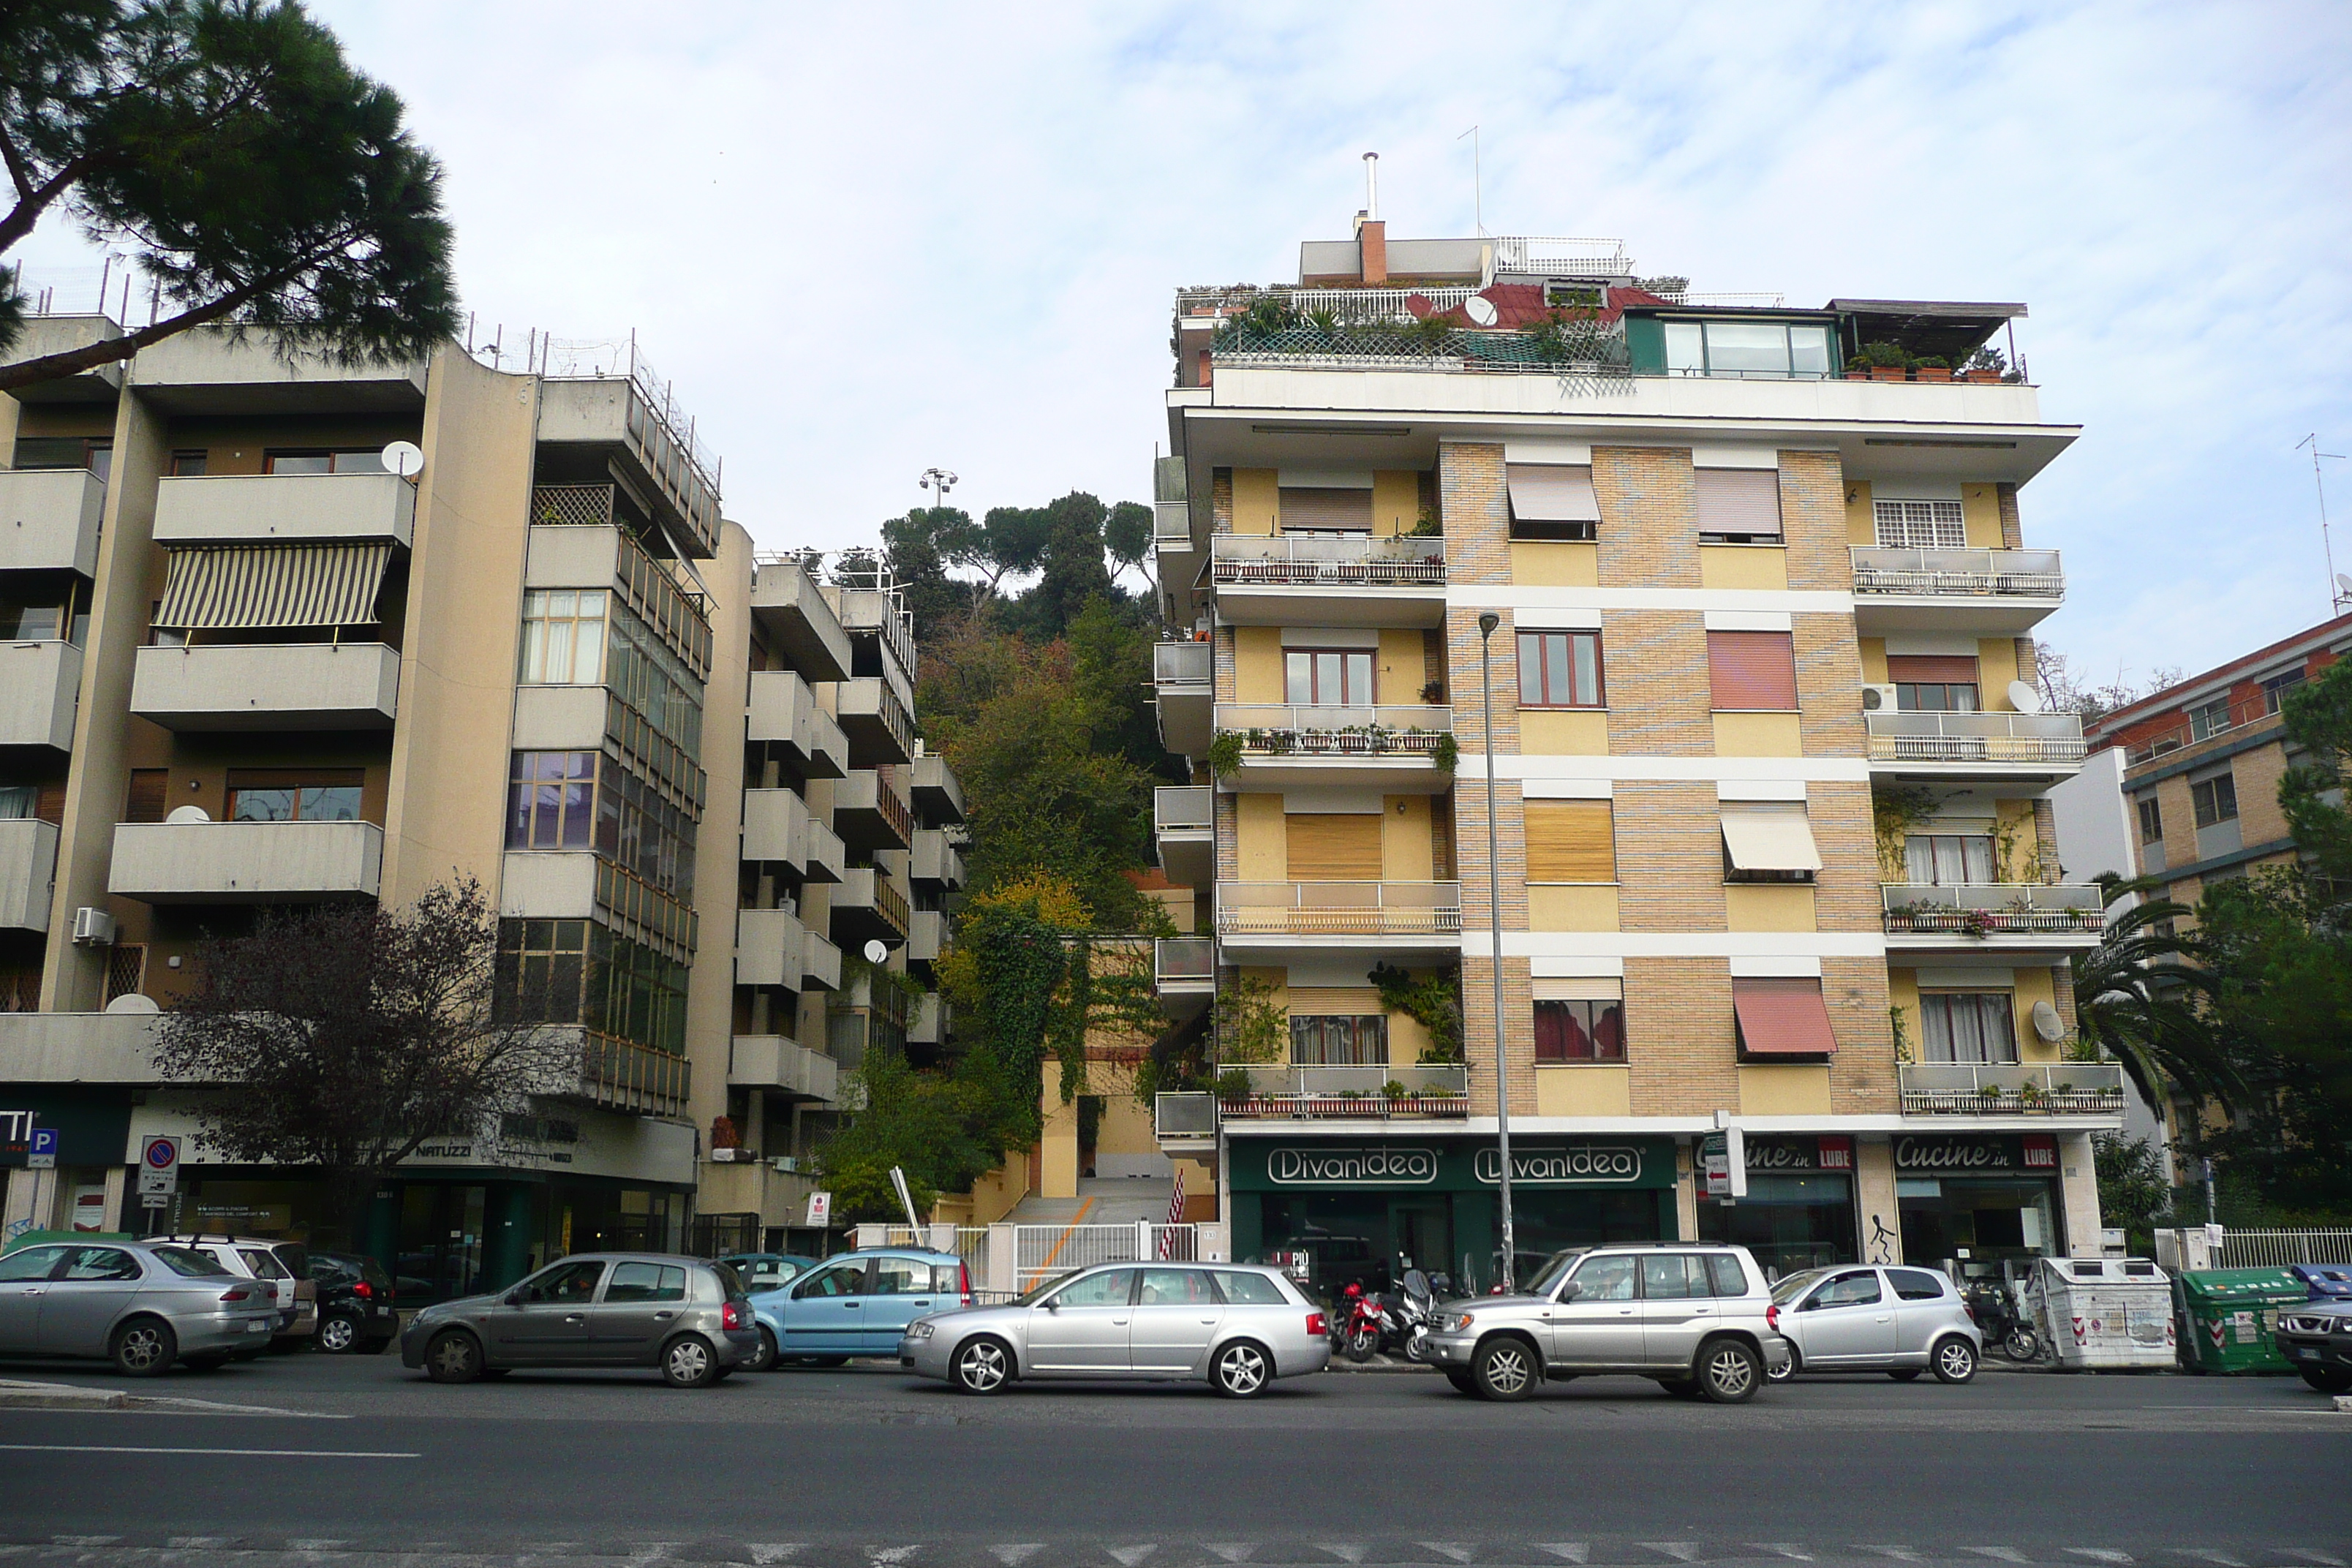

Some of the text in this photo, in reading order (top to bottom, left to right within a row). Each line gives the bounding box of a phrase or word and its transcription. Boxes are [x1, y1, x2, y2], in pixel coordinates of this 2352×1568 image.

[0, 1110, 34, 1141] TI
[35, 1133, 51, 1151] P
[415, 1145, 472, 1157] NATUZZI
[1792, 1153, 1811, 1168] in
[1820, 1150, 1850, 1168] LUBE
[1896, 1137, 2056, 1168] Cucine in LUBE
[1281, 1145, 1428, 1179] Divanidea
[1292, 1248, 1309, 1266] PIÙ
